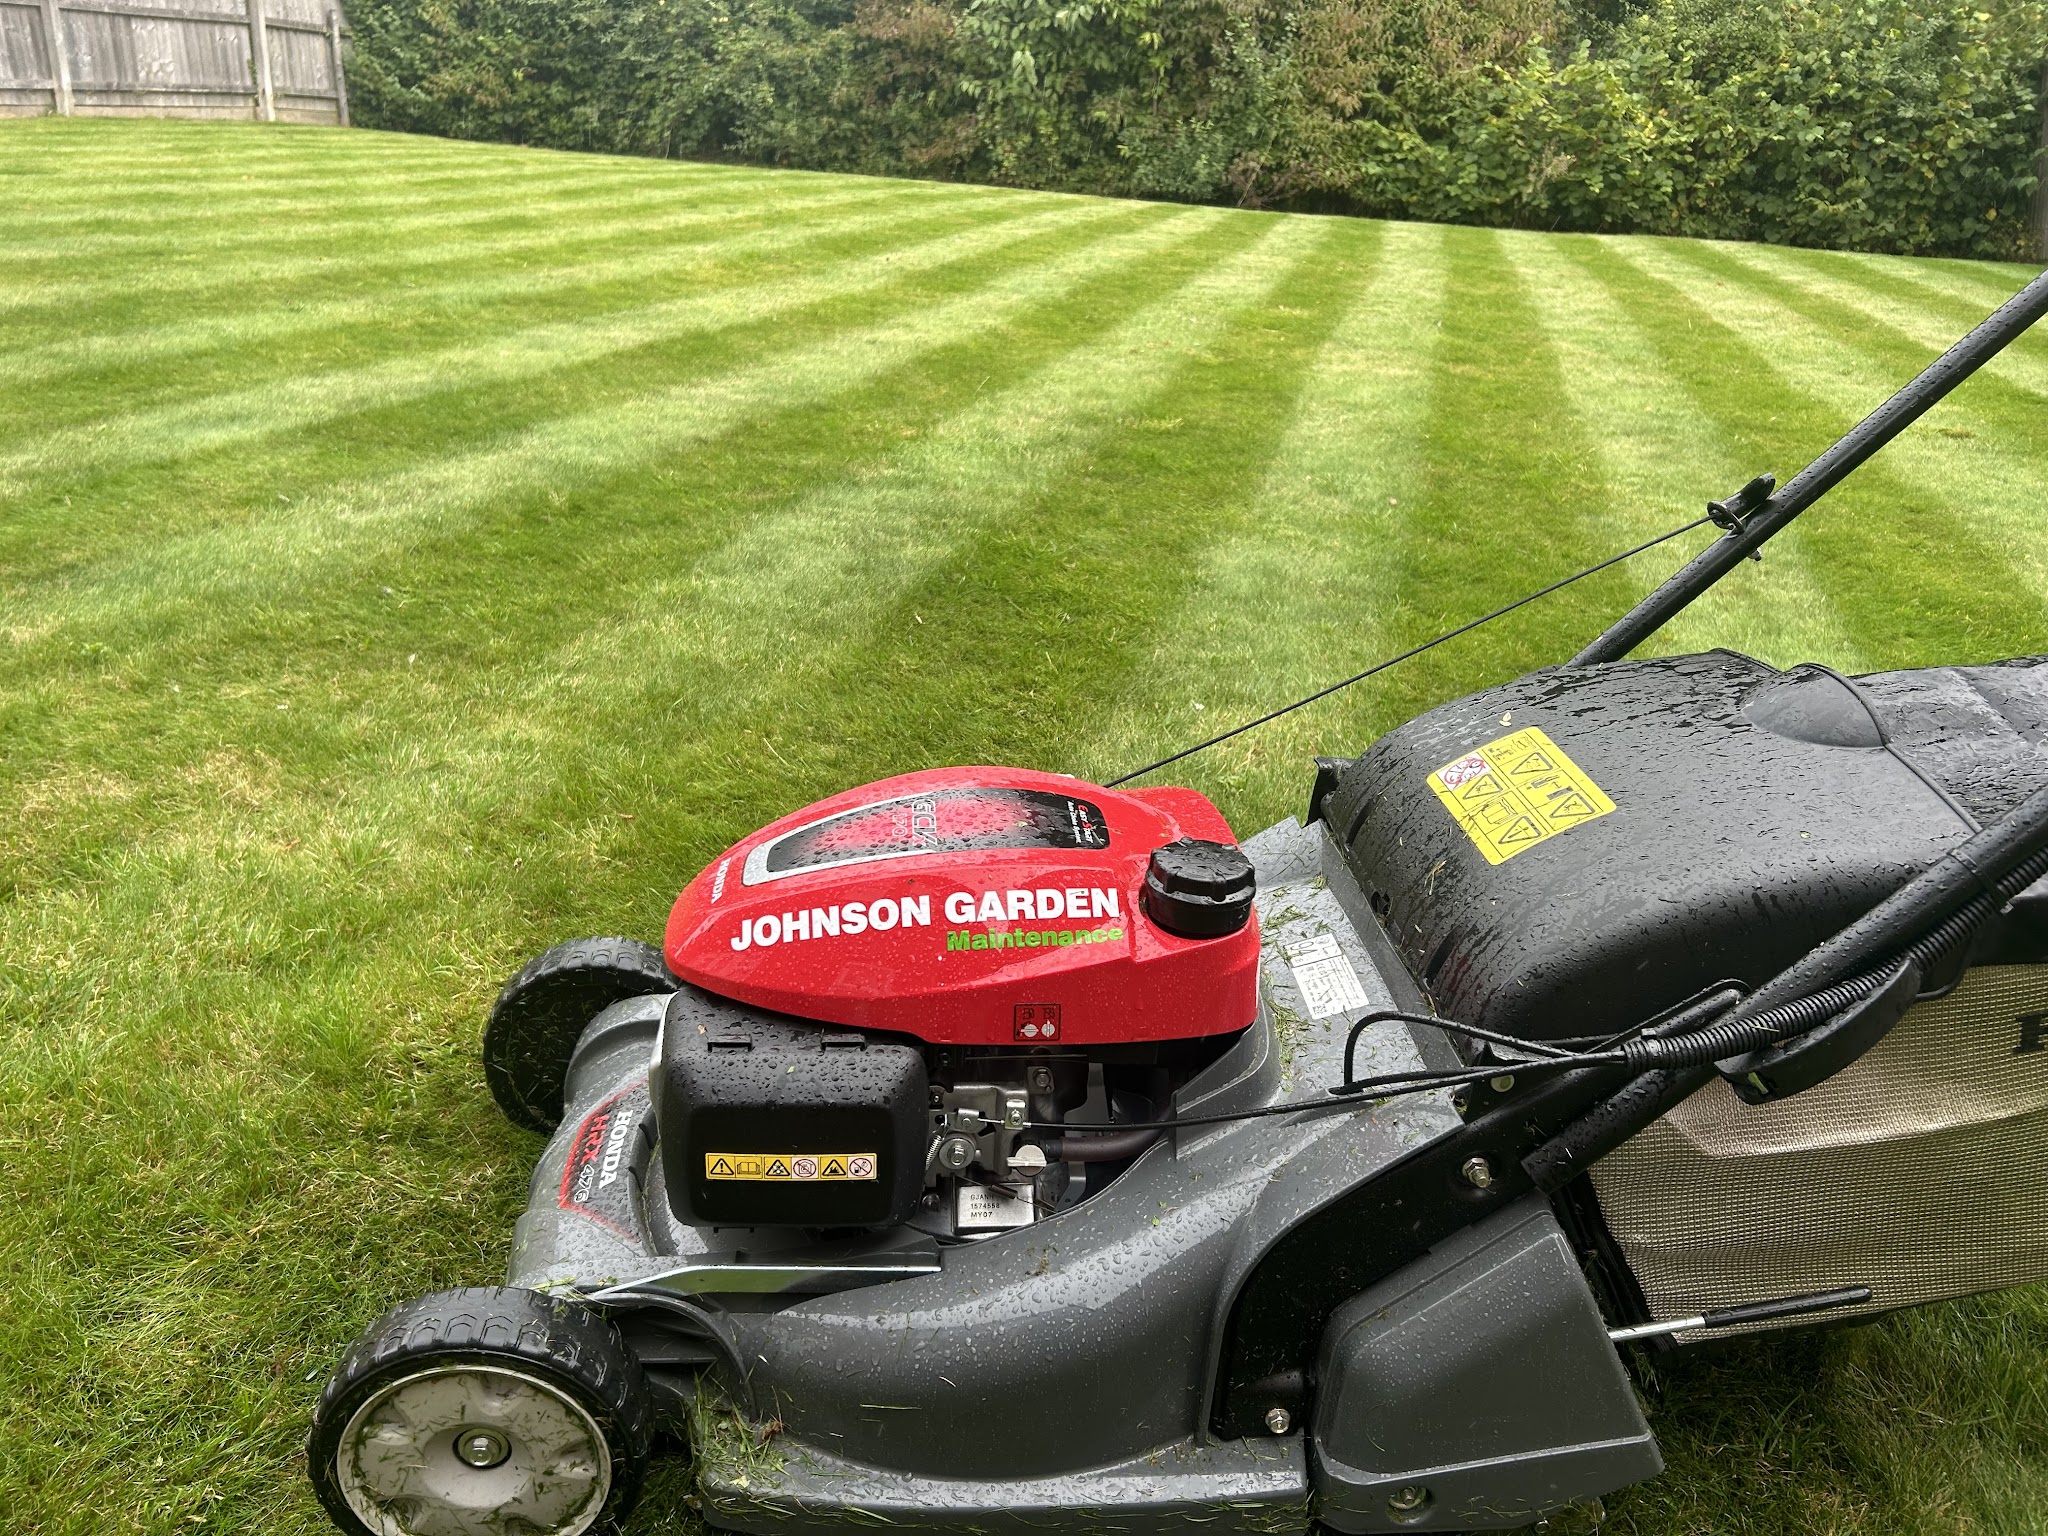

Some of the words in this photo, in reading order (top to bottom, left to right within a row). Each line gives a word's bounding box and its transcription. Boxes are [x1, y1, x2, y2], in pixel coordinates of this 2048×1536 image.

[711, 856, 732, 904] HONDA
[731, 895, 931, 952] JOHNSON
[944, 887, 1120, 924] GARDEN
[946, 927, 1125, 952] Maintenance
[598, 1109, 634, 1189] HONDA
